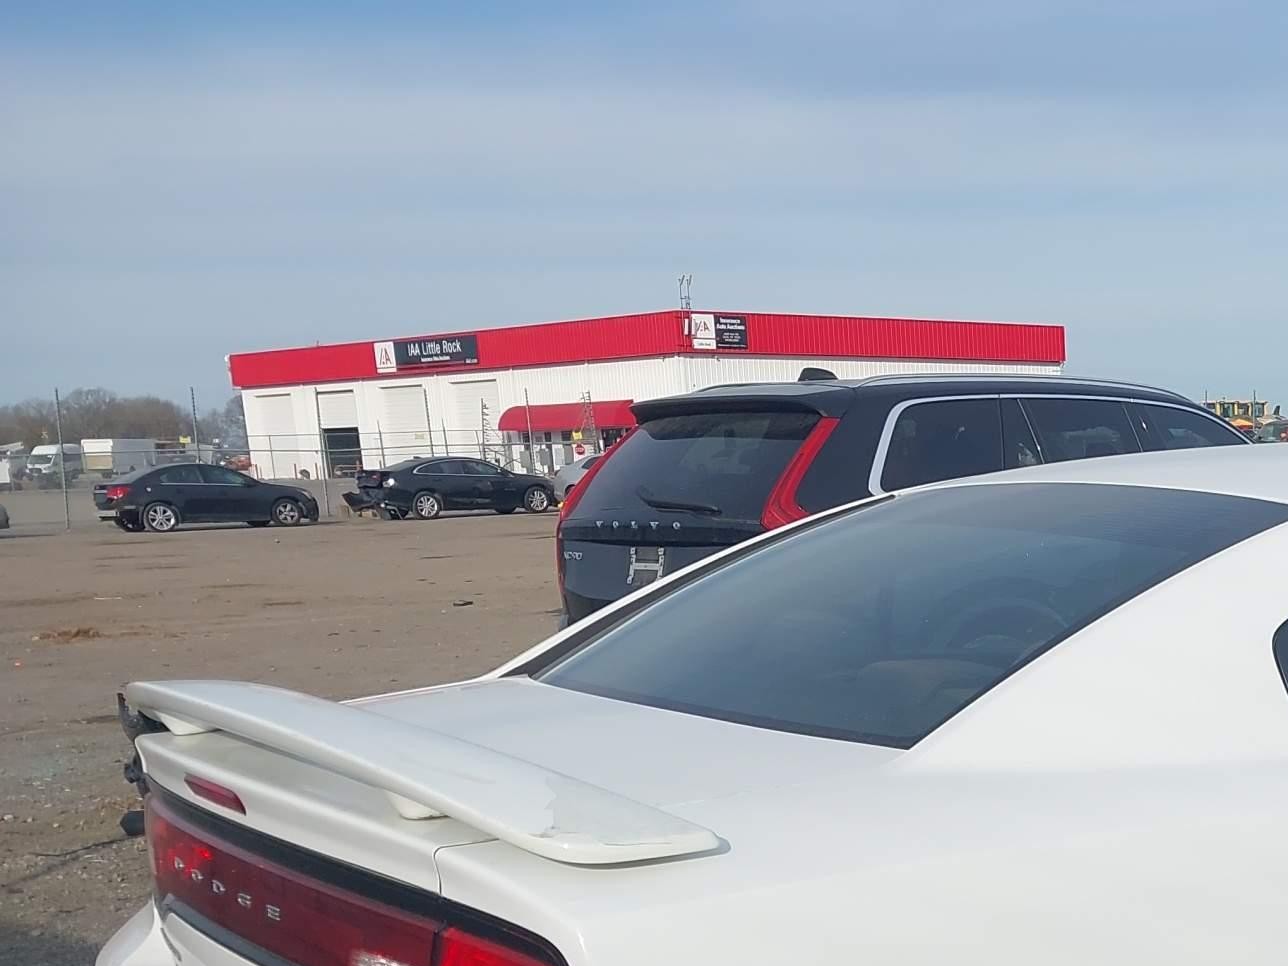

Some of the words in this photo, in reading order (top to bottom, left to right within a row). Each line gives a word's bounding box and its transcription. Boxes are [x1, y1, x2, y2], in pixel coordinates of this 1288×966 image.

[407, 342, 420, 357] IAA
[421, 340, 441, 355] Little
[442, 339, 462, 353] Rock
[595, 520, 681, 530] VOLVO
[173, 855, 281, 921] DODGE
